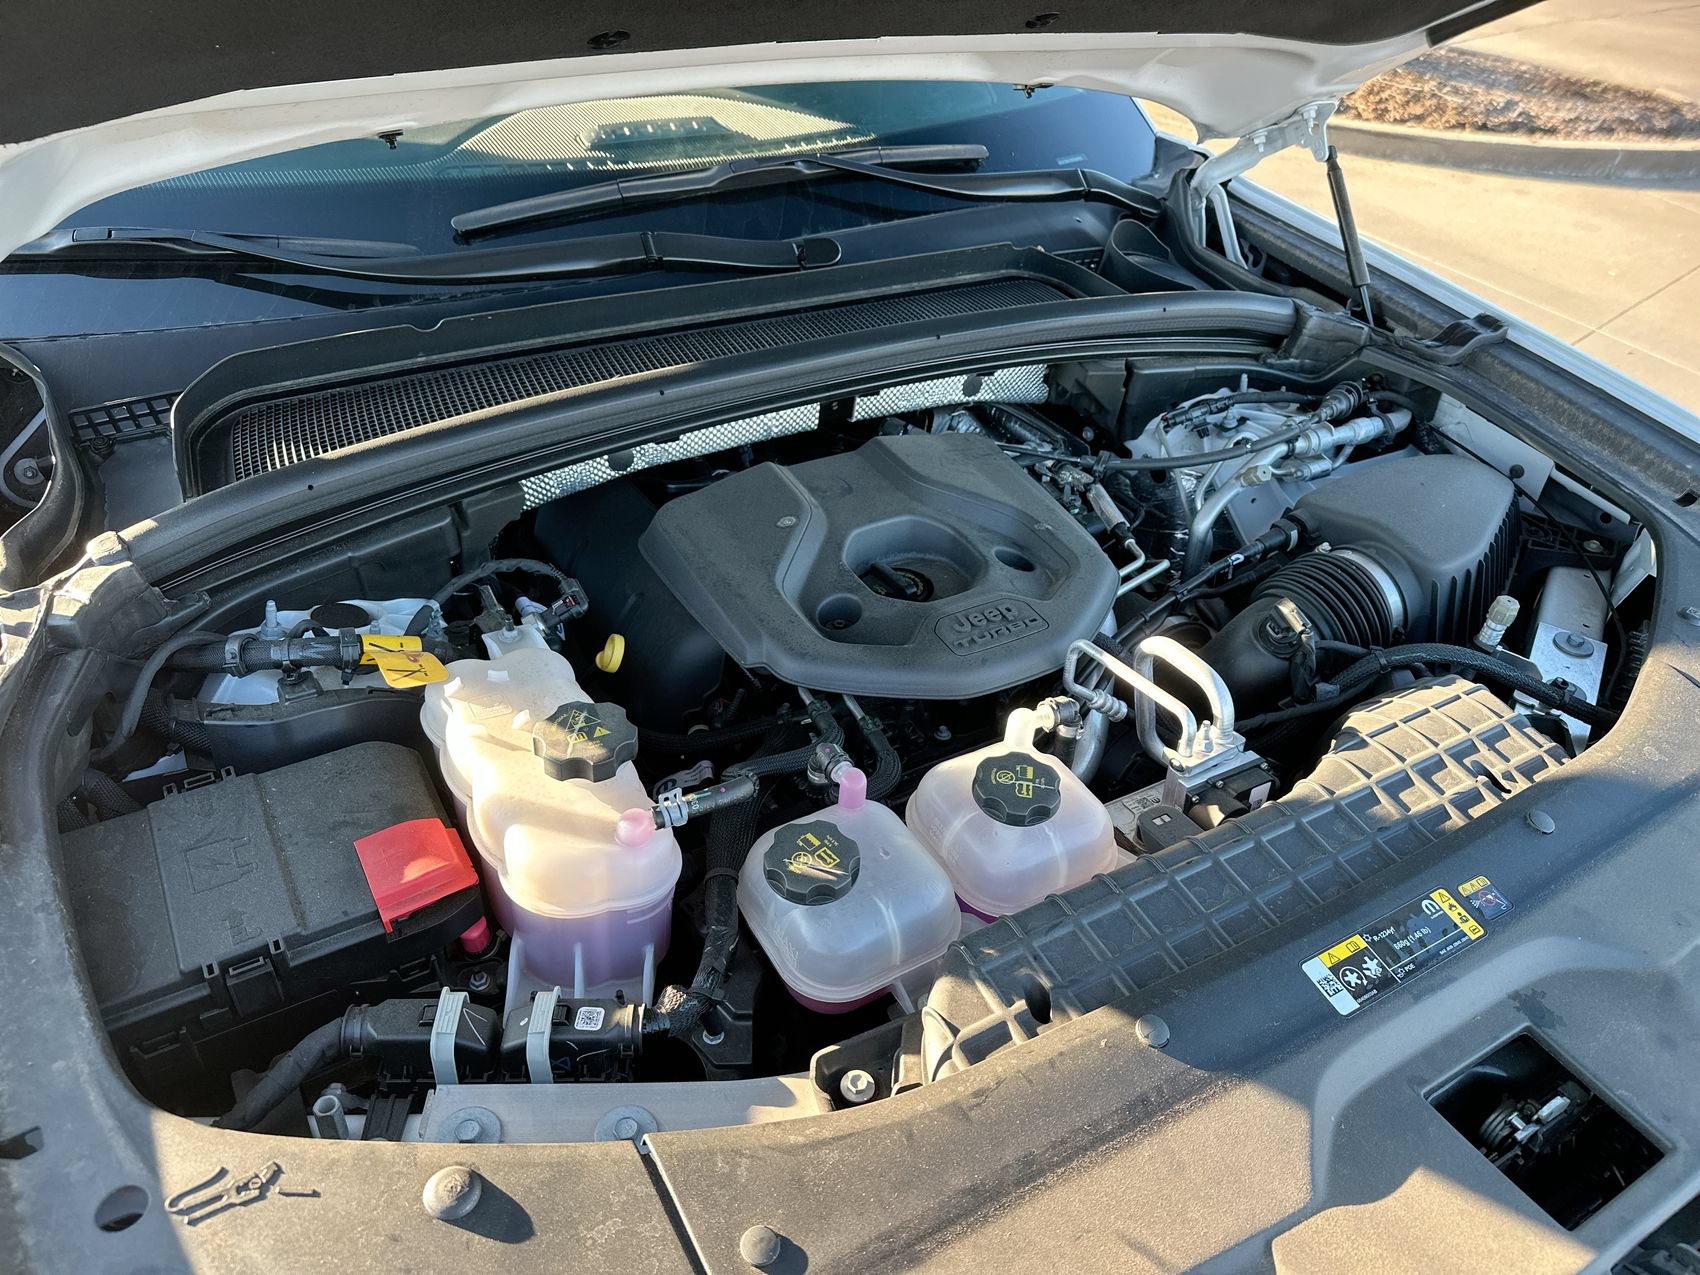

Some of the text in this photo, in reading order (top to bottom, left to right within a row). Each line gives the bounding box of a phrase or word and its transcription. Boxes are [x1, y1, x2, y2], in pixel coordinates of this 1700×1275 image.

[952, 603, 1018, 633] Jeep
[953, 617, 1040, 647] TURBO
[1373, 926, 1396, 941] R-1234yf
[1393, 939, 1411, 950] 660g
